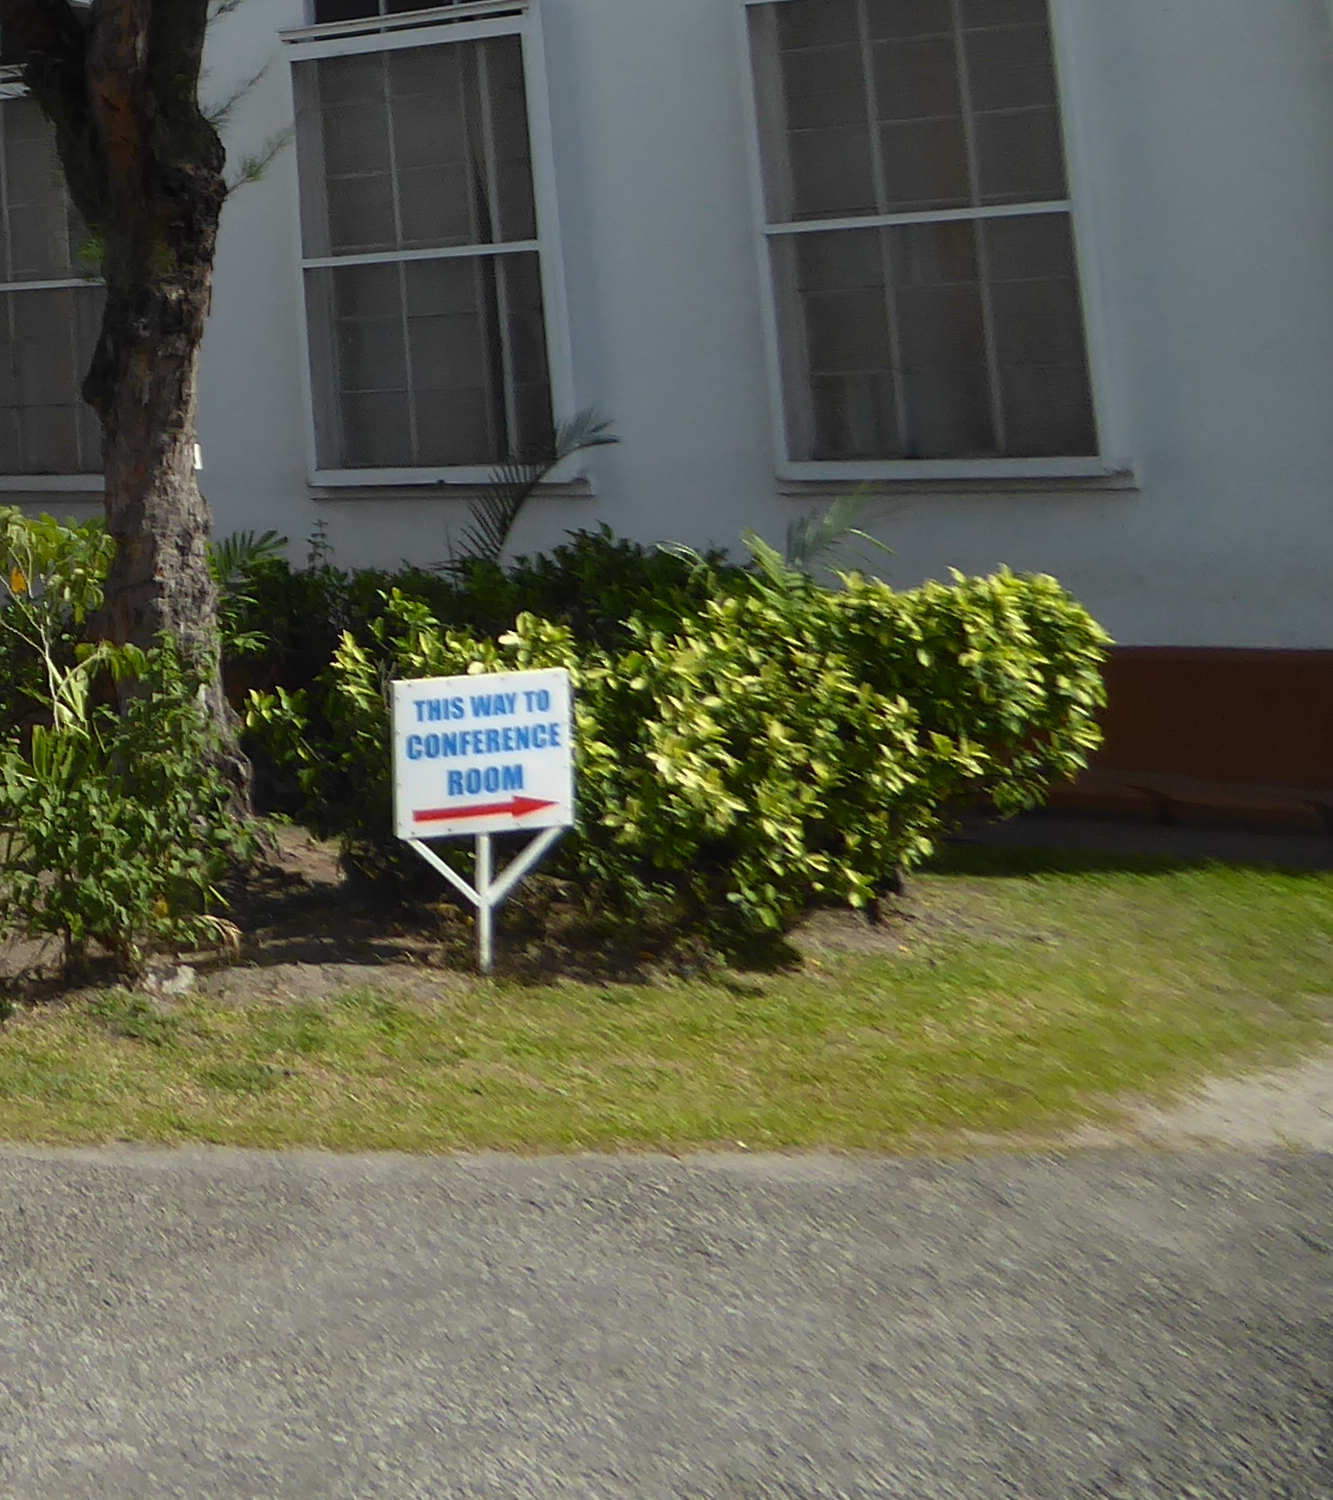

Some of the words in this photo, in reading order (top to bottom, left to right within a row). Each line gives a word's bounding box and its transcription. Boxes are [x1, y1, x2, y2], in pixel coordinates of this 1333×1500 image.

[413, 696, 465, 722] THIS
[469, 692, 517, 717] WAY
[523, 688, 551, 712] TO
[406, 722, 561, 760] CONFERENCE
[446, 764, 525, 796] ROOM
